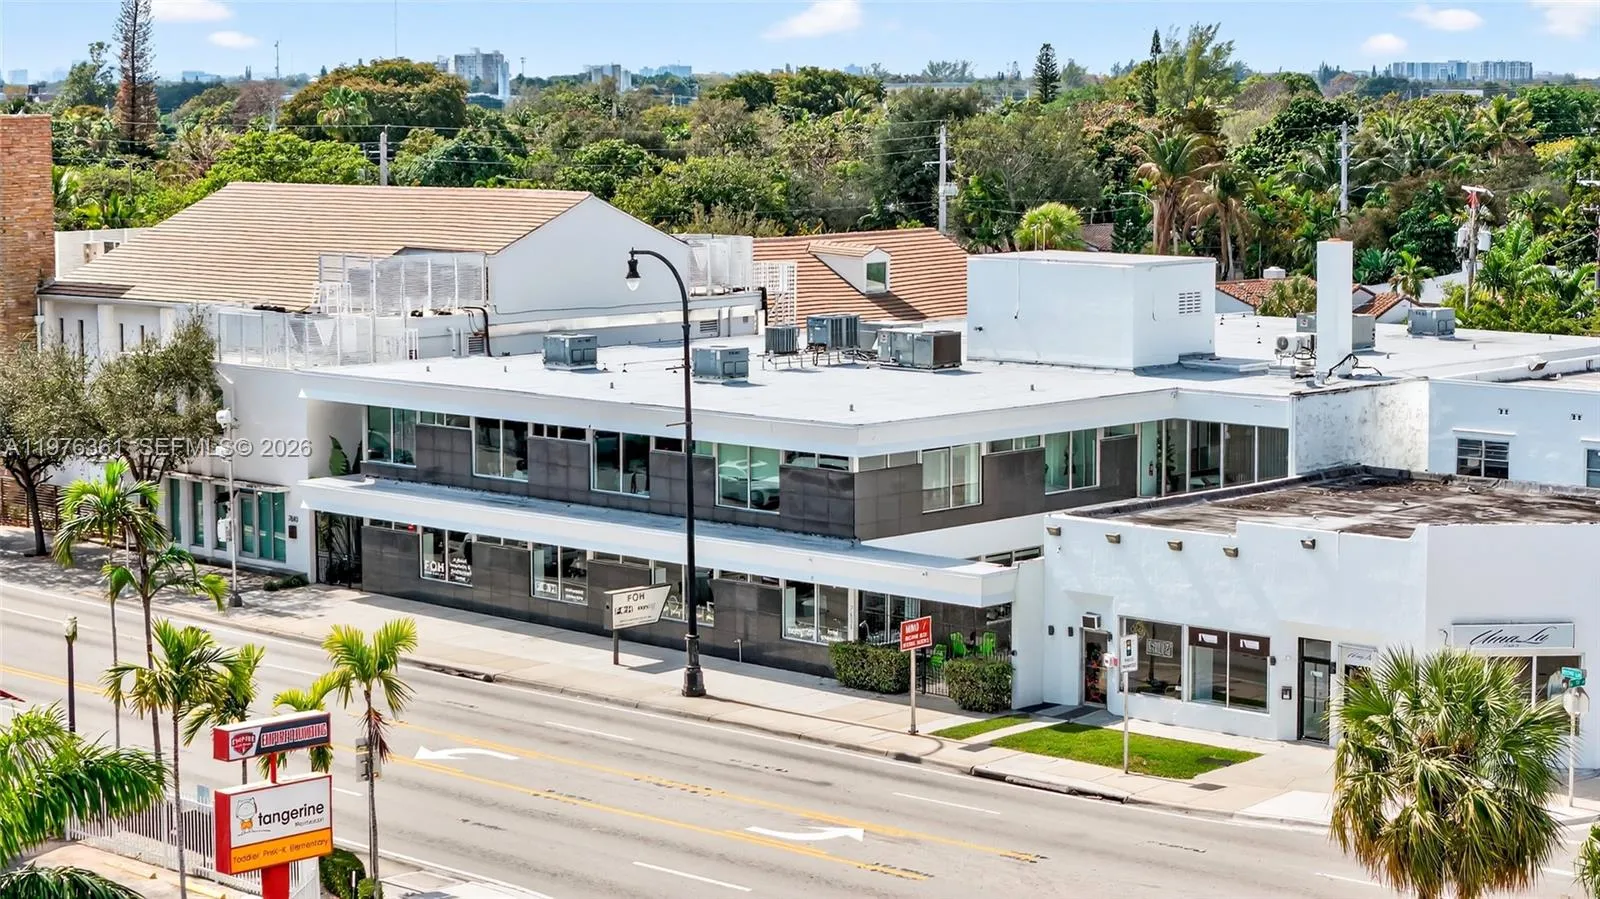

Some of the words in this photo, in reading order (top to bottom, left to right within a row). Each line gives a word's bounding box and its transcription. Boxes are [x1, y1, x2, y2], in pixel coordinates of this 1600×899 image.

[424, 560, 445, 573] FOH
[627, 592, 645, 602] FOH
[258, 803, 325, 826] tangerine
[289, 839, 328, 853] Elementary
